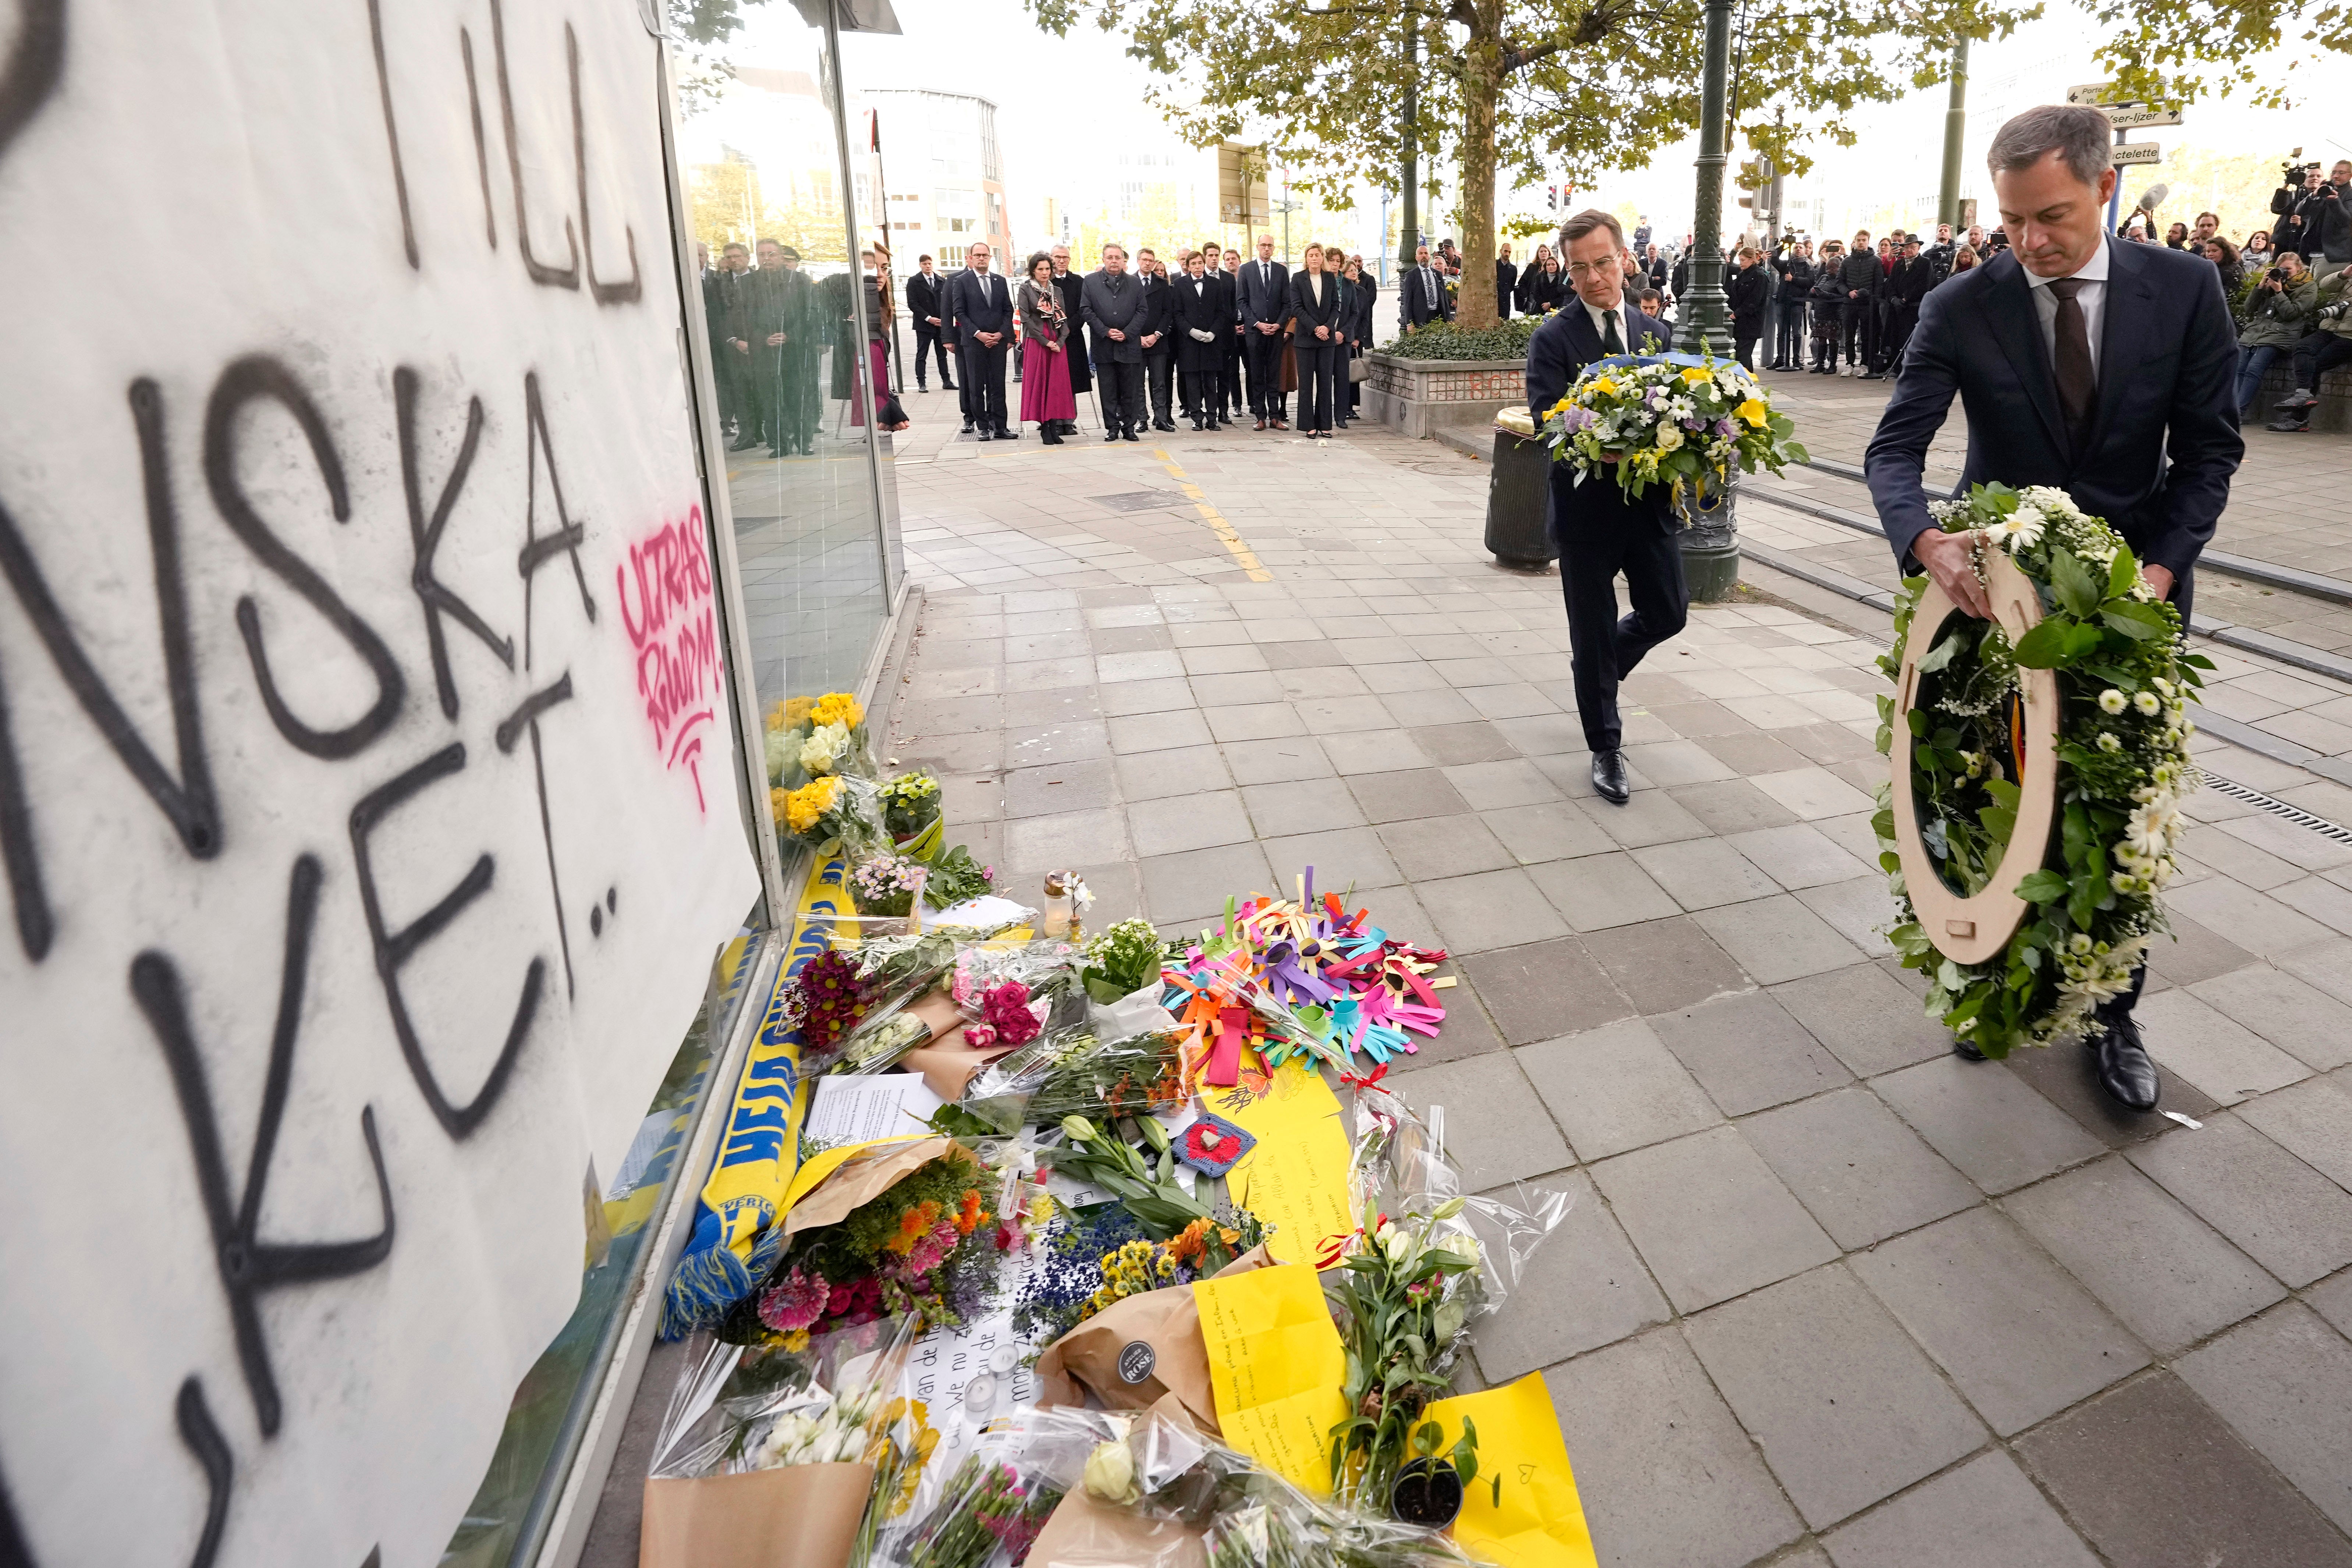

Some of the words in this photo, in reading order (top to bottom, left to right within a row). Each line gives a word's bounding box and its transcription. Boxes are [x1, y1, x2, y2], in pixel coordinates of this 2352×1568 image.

[2109, 113, 2158, 123] ser-Ijzer
[2112, 150, 2157, 159] ctelette
[971, 1331, 996, 1351] de
[912, 1347, 937, 1366] de
[951, 1352, 966, 1372] nu
[1127, 1353, 1153, 1380] ROSE
